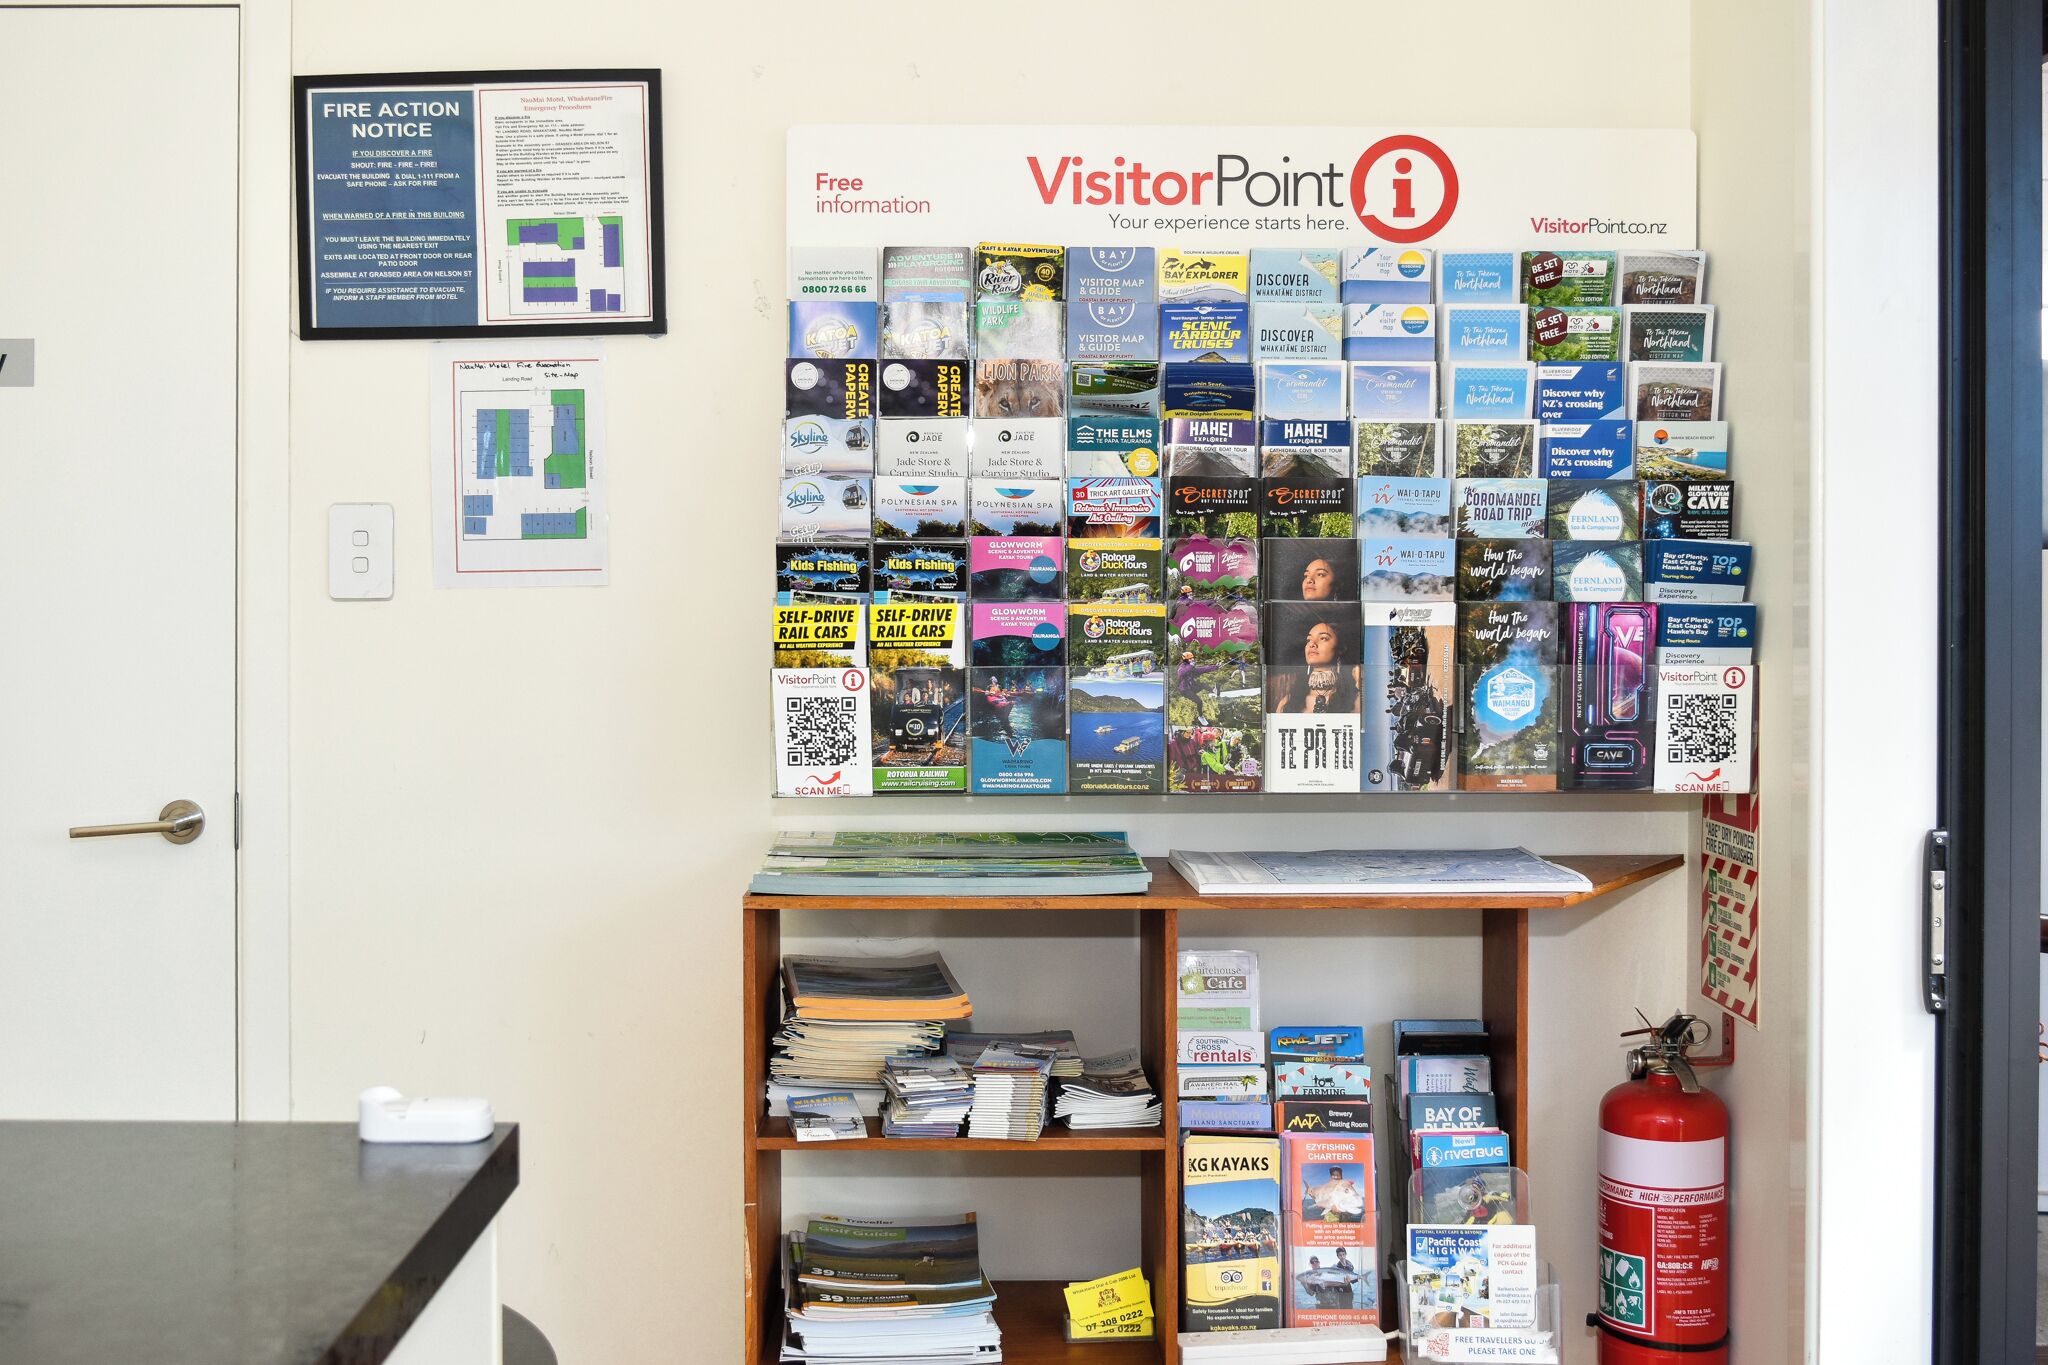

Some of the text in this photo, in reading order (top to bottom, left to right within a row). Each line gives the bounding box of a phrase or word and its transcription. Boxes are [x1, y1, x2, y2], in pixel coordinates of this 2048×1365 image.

[324, 102, 460, 117] FIRE ACTION
[352, 123, 432, 137] NOTICE
[816, 172, 863, 192] Free
[1026, 154, 1344, 207] VisitorPoint
[816, 194, 930, 214] information
[1109, 212, 1350, 233] Your experience starts here.
[1530, 217, 1667, 235] VisitorPoint.co.nz
[1533, 258, 1559, 274] BE SET
[983, 273, 1015, 287] River
[1164, 271, 1239, 280] BAY EXPLORER
[1256, 274, 1309, 286] DISCOVER
[1079, 278, 1145, 287] VISITOR MAP
[1454, 279, 1501, 291] Northland
[802, 285, 867, 294] 0800 72 66 66
[991, 283, 1012, 294] Rats
[1079, 287, 1121, 295] & GUIDE
[1256, 288, 1322, 297] WHAKATĀNE DISTRICT
[981, 304, 1019, 318] WILDLIFE
[981, 315, 1005, 326] PARK
[1182, 321, 1231, 331] SCENIC
[1169, 331, 1241, 340] HARBOUR
[1173, 340, 1234, 349] CRUISES
[983, 363, 1059, 380] LION PARK
[858, 363, 869, 417] CREATE
[1542, 389, 1604, 400] Discover why
[1542, 400, 1604, 411] NZ's crossing
[1542, 411, 1562, 419] over
[1096, 428, 1152, 437] THE ELMS
[1284, 424, 1327, 439] HAHEI
[921, 434, 942, 442] JADE
[896, 458, 951, 466] Jade Store &
[1075, 490, 1085, 498] 3D
[1396, 489, 1441, 499] WAI-O-TAPU
[881, 498, 937, 506] POLYNESIAN
[1466, 493, 1542, 507] COROMANDEL
[1687, 497, 1730, 509] CAVE
[1474, 508, 1532, 521] ROAD TRIP
[1571, 515, 1619, 524] FERNLAND
[989, 541, 1043, 549] GLOWWORM
[1101, 553, 1135, 562] Rotorua
[1195, 555, 1215, 563] CANOPY
[790, 560, 857, 574] Kids Fishing
[1101, 561, 1147, 569] DuckTours
[1195, 564, 1211, 572] TOURS
[778, 610, 854, 623] SELF-DRIVE
[1488, 611, 1510, 623] How
[778, 626, 848, 639] RAIL CARS
[1514, 627, 1551, 643] began
[1660, 671, 1717, 683] VisitorPoint
[1278, 724, 1354, 769] TE PĀ TŪ
[881, 778, 956, 789] www.railcruising.com
[1675, 783, 1721, 792] SCAN ME
[1721, 828, 1732, 843] DRY
[1733, 831, 1754, 849] POWDER
[1706, 839, 1753, 866] FIRE EXTINGUISHER
[1207, 978, 1243, 989] Cafe
[1193, 1050, 1251, 1063] rentals
[1329, 1110, 1353, 1118] Brewery
[1425, 1107, 1481, 1121] BAY OF
[1329, 1120, 1349, 1128] Tasting
[1306, 1143, 1355, 1151] EZYFISHING
[1188, 1157, 1269, 1172] KG KAYAKS
[1639, 1189, 1723, 1203] HIGH PERFORMANCE
[846, 1217, 894, 1225] Traveller
[818, 1225, 898, 1238] Golf Guide
[1428, 1237, 1456, 1246] Pacific
[810, 1267, 835, 1276] 39
[1086, 1310, 1144, 1332] 07 308 0222
[1475, 1336, 1522, 1344] TRAVELLERS
[1468, 1347, 1497, 1355] PLEASE
